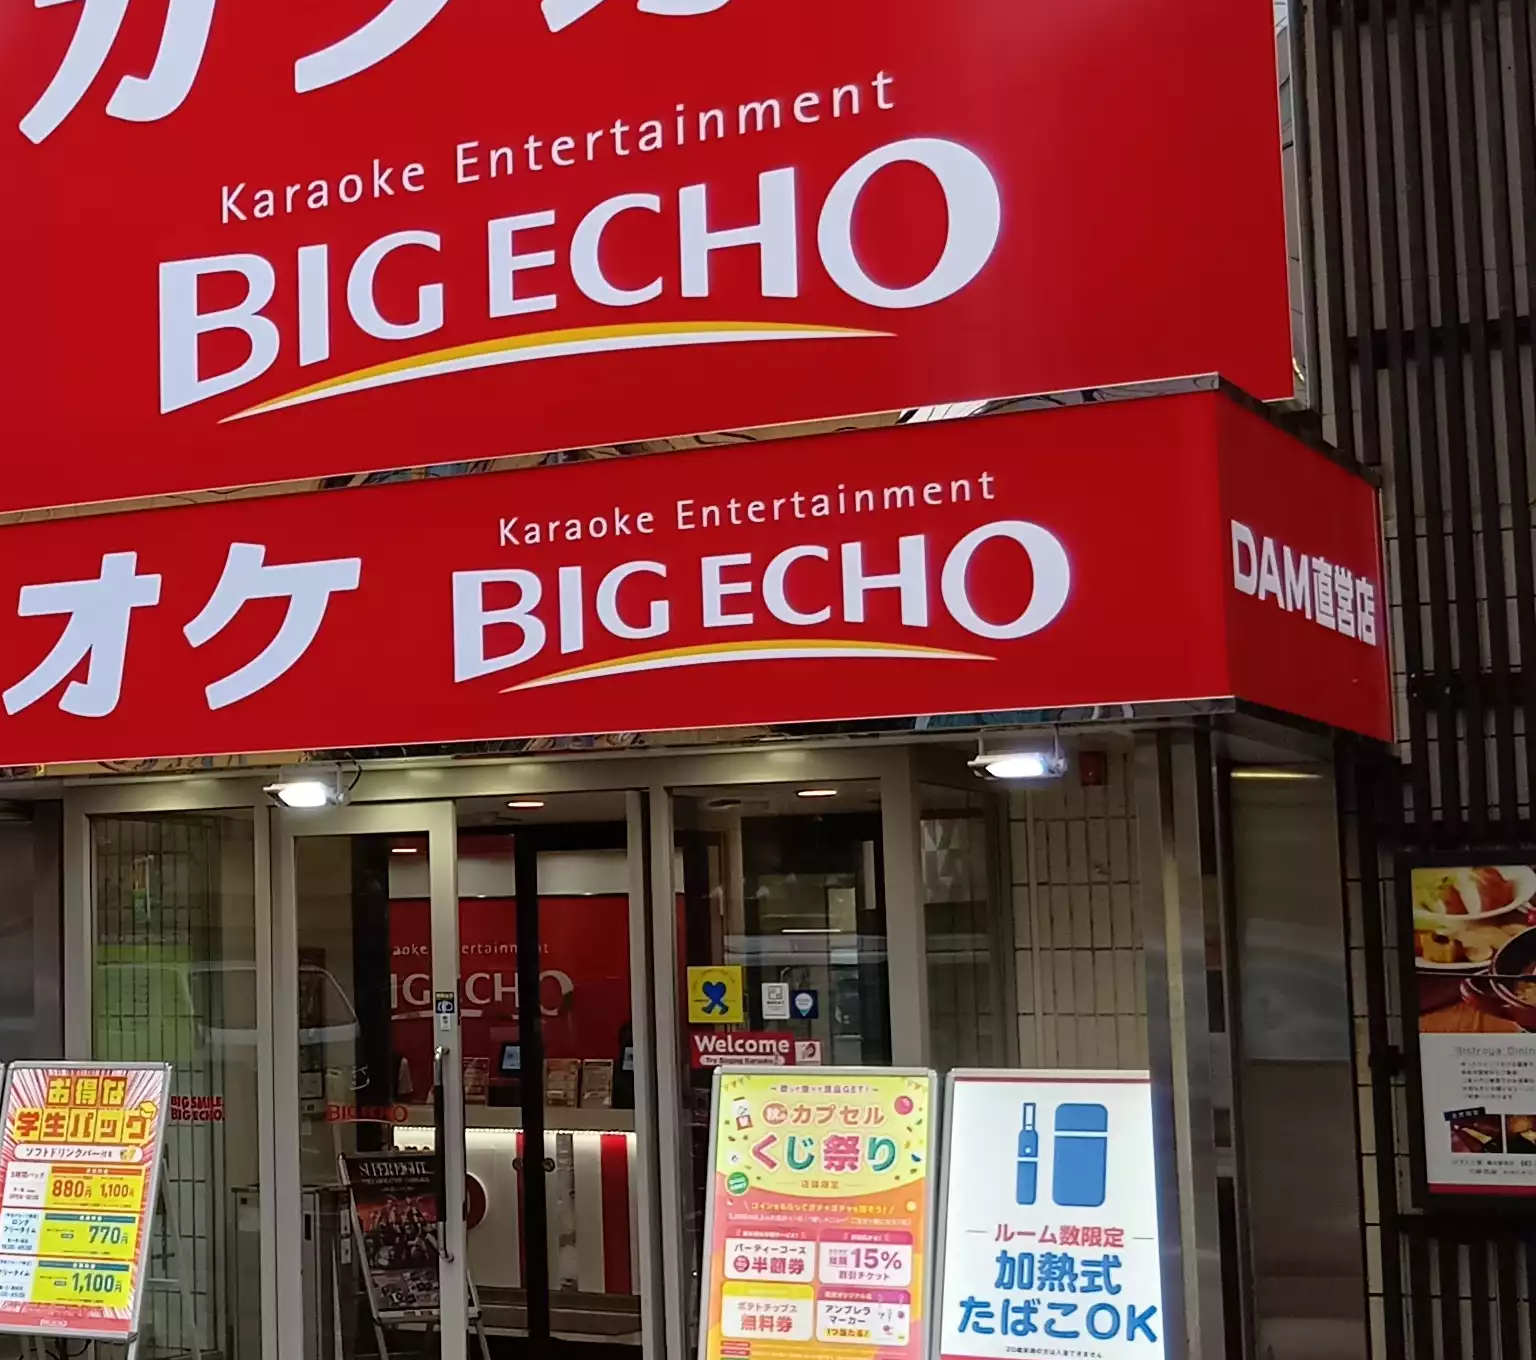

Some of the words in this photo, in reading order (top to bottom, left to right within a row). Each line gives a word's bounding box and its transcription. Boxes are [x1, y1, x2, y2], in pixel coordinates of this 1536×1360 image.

[219, 159, 427, 224] Karaoke
[454, 69, 896, 185] Entertainment
[157, 228, 444, 416] BIG
[487, 137, 1002, 319] ECHO
[498, 506, 654, 548] Karaoke
[676, 470, 997, 532] Entertainment
[1231, 519, 1377, 646] DAM直営店
[451, 560, 670, 685] BIG
[701, 520, 1070, 640] ECHO
[392, 943, 429, 956] aoke
[390, 973, 431, 1009] IG
[694, 1034, 790, 1053] Welcome
[48, 1077, 125, 1106] お得な
[171, 1096, 189, 1108] BIG
[16, 1111, 148, 1141] 学生パック
[171, 1108, 191, 1120] BIG
[792, 1103, 885, 1126] カプセル
[751, 1134, 897, 1172] くじ祭り
[994, 1223, 1125, 1248] ルーム数限定
[851, 1248, 902, 1271] 15%
[994, 1249, 1123, 1296] 加熱式
[740, 1314, 794, 1333] 無料券
[958, 1296, 1158, 1343] たばこOK
